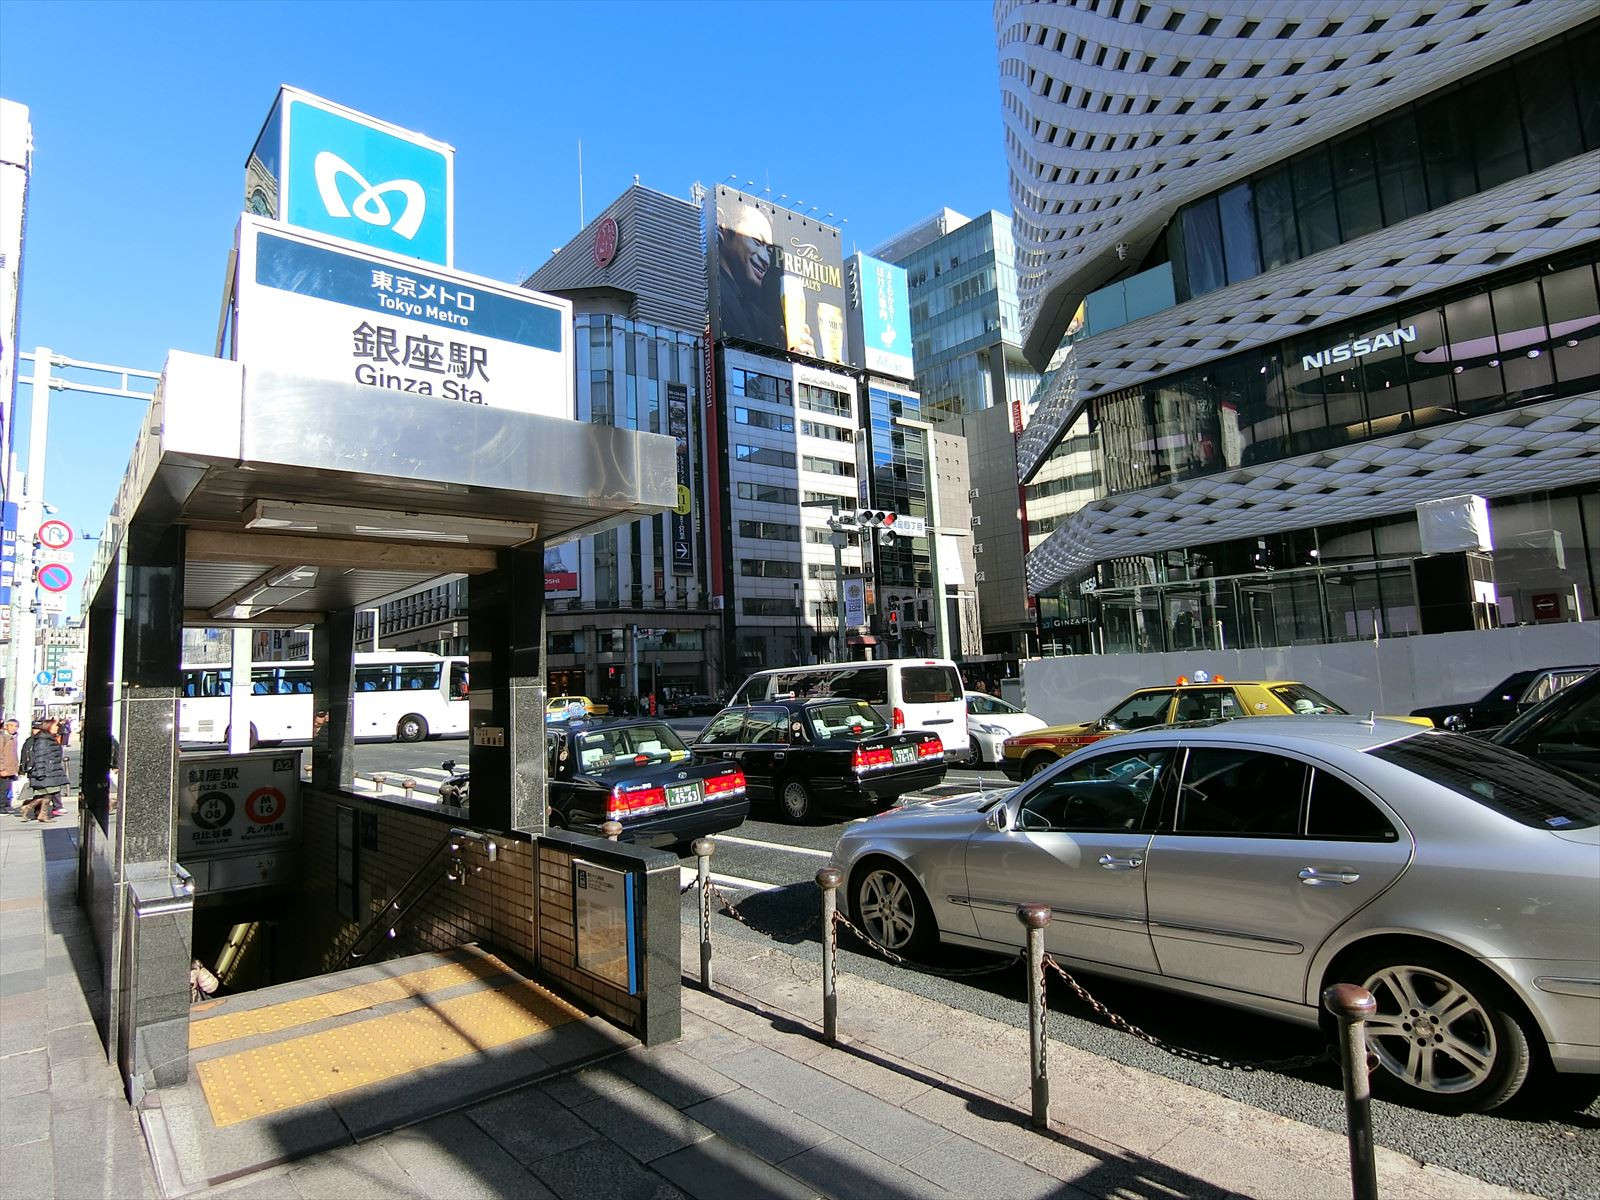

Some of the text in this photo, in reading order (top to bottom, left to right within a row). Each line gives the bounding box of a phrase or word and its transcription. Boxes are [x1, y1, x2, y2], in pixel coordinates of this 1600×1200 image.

[790, 237, 824, 262] The
[775, 248, 842, 289] PREMIUM
[371, 269, 475, 311] 東京メトロ
[378, 293, 469, 326] Tokyo Metro
[352, 321, 490, 383] 銀座駅
[1302, 325, 1416, 371] NISSAN
[355, 364, 489, 406] Ginza Sta.
[1053, 619, 1080, 627] GINZA
[275, 759, 293, 770] A2
[188, 767, 239, 783] 銀座駅
[210, 801, 218, 809] H
[260, 796, 271, 804] M
[205, 810, 222, 819] 08
[259, 804, 274, 814] 16
[192, 828, 233, 841] 日比谷線
